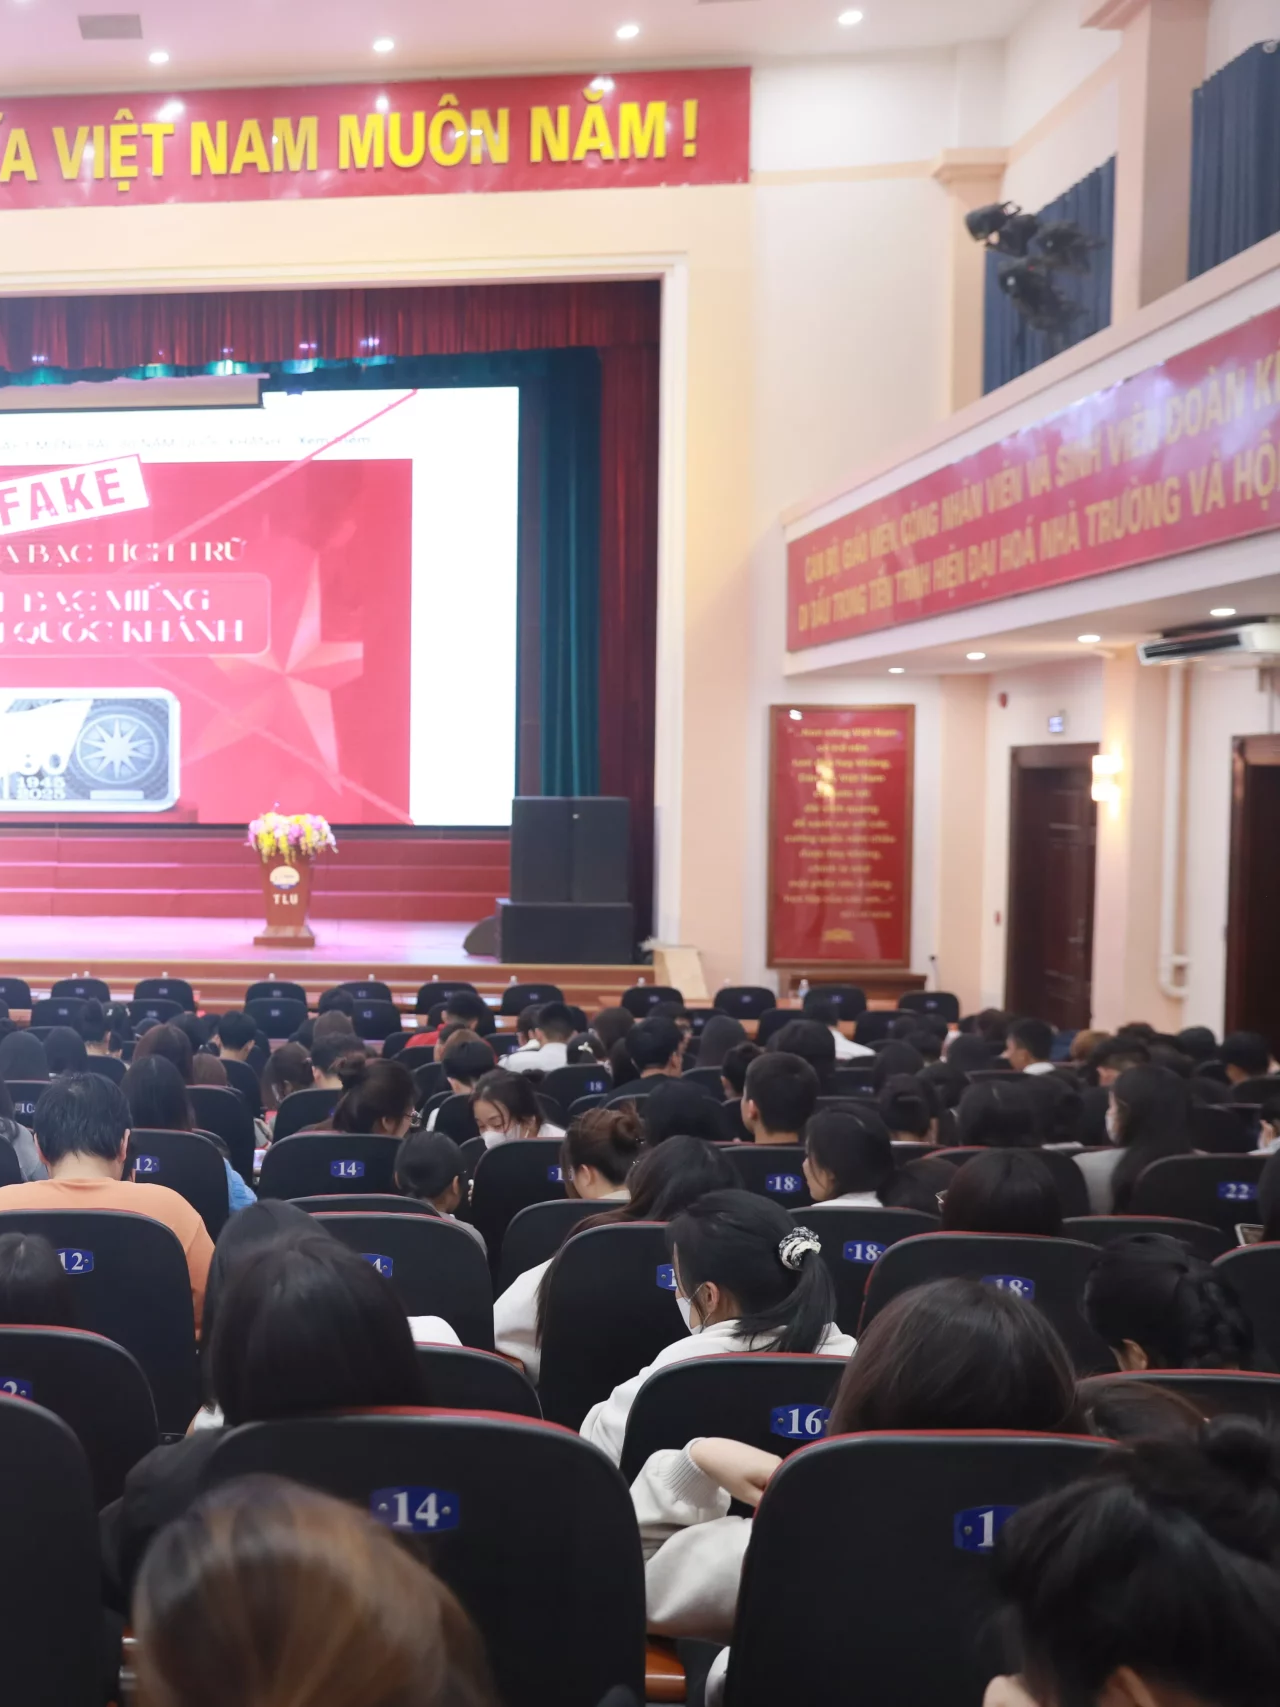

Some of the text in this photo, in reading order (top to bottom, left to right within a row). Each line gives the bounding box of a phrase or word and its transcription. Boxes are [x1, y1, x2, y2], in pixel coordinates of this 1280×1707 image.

[54, 110, 174, 190] VIỆT
[191, 117, 317, 174] NAM
[340, 95, 508, 168] MUÔN
[531, 89, 666, 161] NĂM
[1085, 475, 1181, 548] TRƯỜNG
[1188, 449, 1226, 517] VÀ
[1233, 428, 1280, 512] HỘ
[123, 615, 243, 643] KHÁNH
[273, 894, 299, 905] TLU
[590, 1082, 602, 1092] 18
[134, 1158, 152, 1171] 12
[337, 1162, 356, 1175] 14
[774, 1176, 794, 1190] 18
[1226, 1184, 1248, 1199] 22
[851, 1242, 875, 1261] 18
[788, 1408, 821, 1436] 16
[390, 1491, 438, 1528] 14
